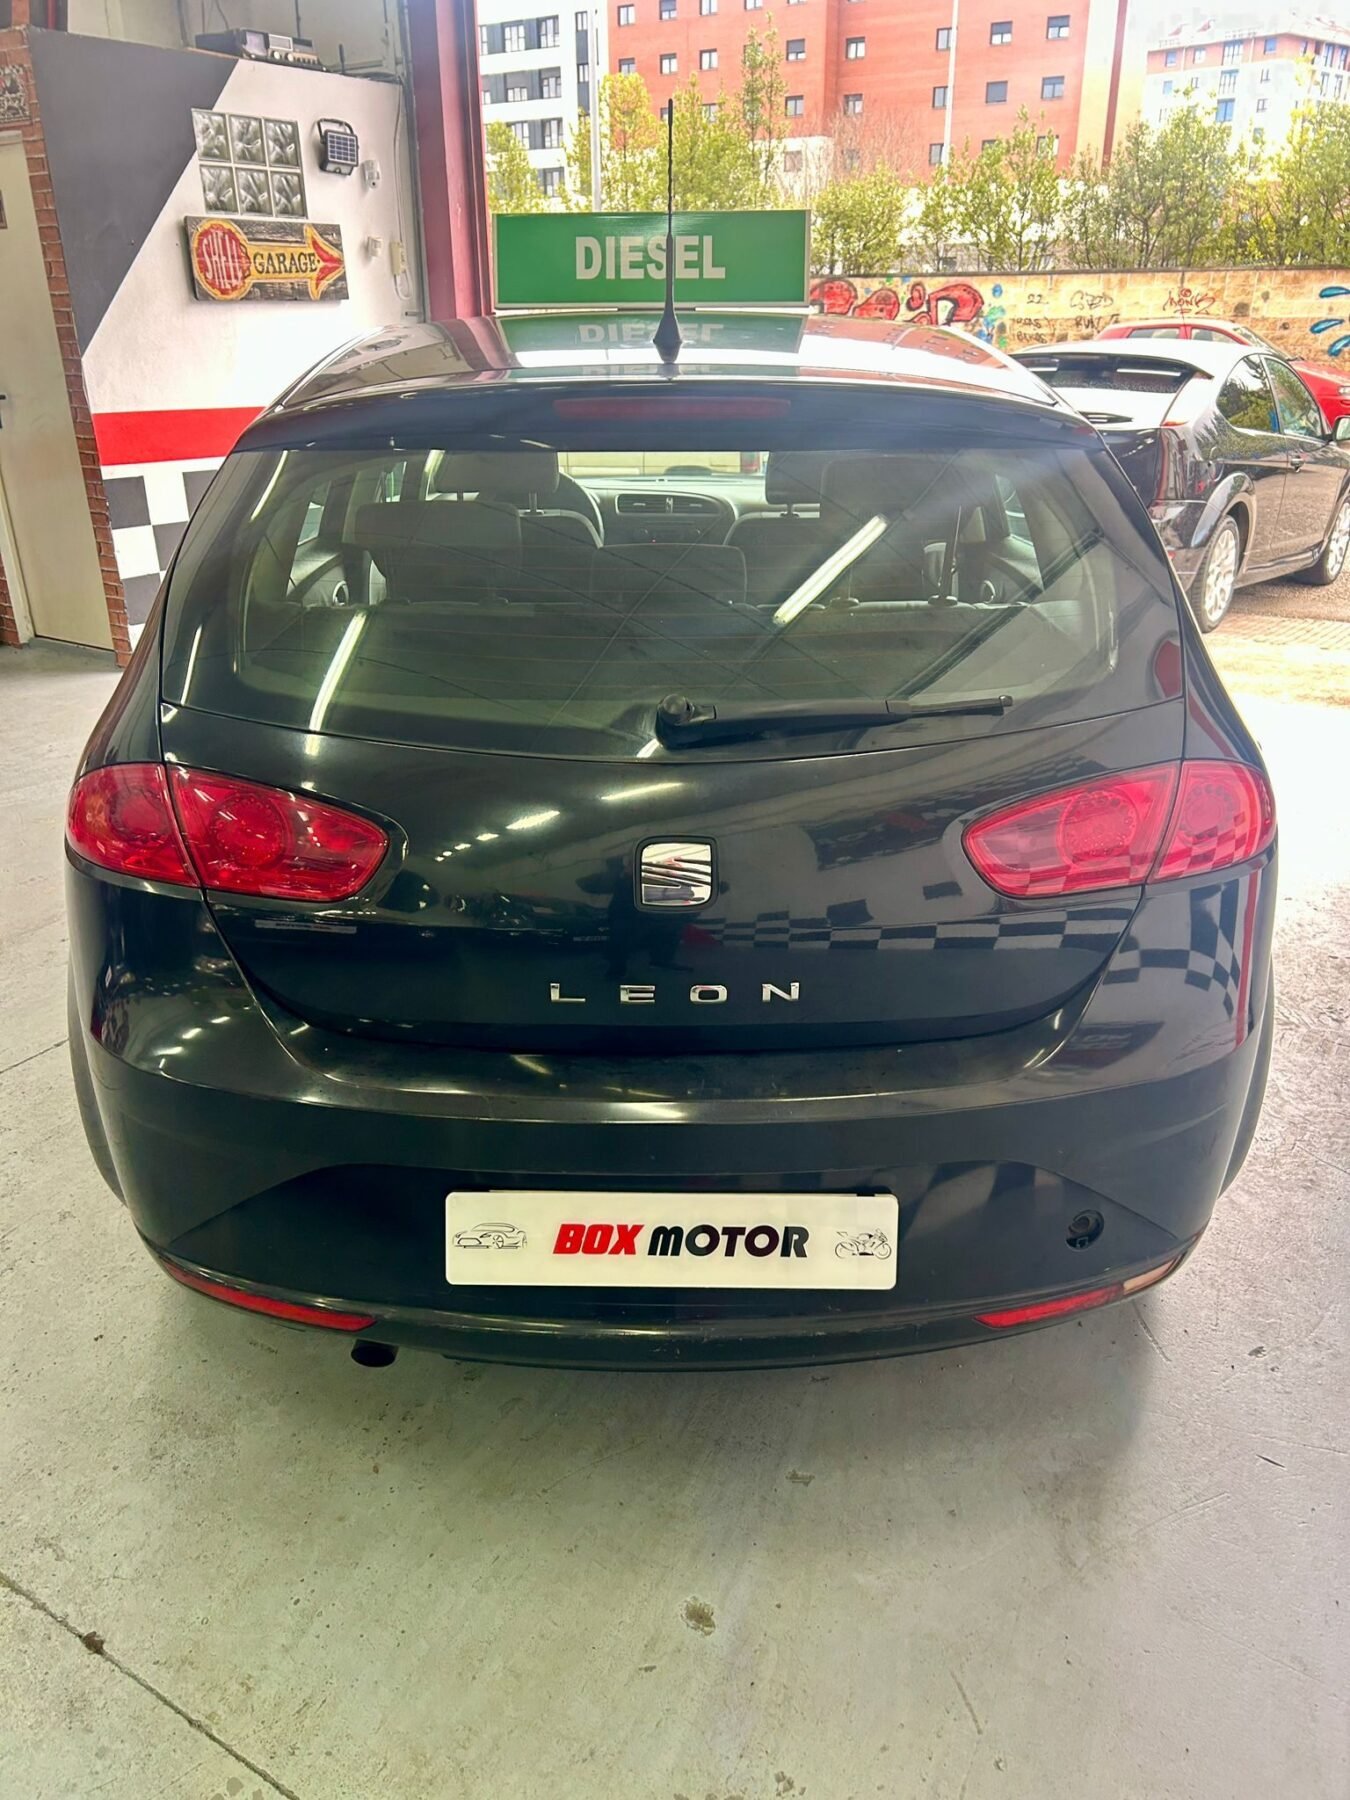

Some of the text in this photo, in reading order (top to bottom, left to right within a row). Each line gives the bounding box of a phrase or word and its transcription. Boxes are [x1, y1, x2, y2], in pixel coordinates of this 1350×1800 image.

[202, 230, 318, 290] SHELL GARAGE
[575, 235, 726, 280] DIESEL
[550, 982, 800, 1003] LEON
[552, 1223, 809, 1258] BOX MOTOR
